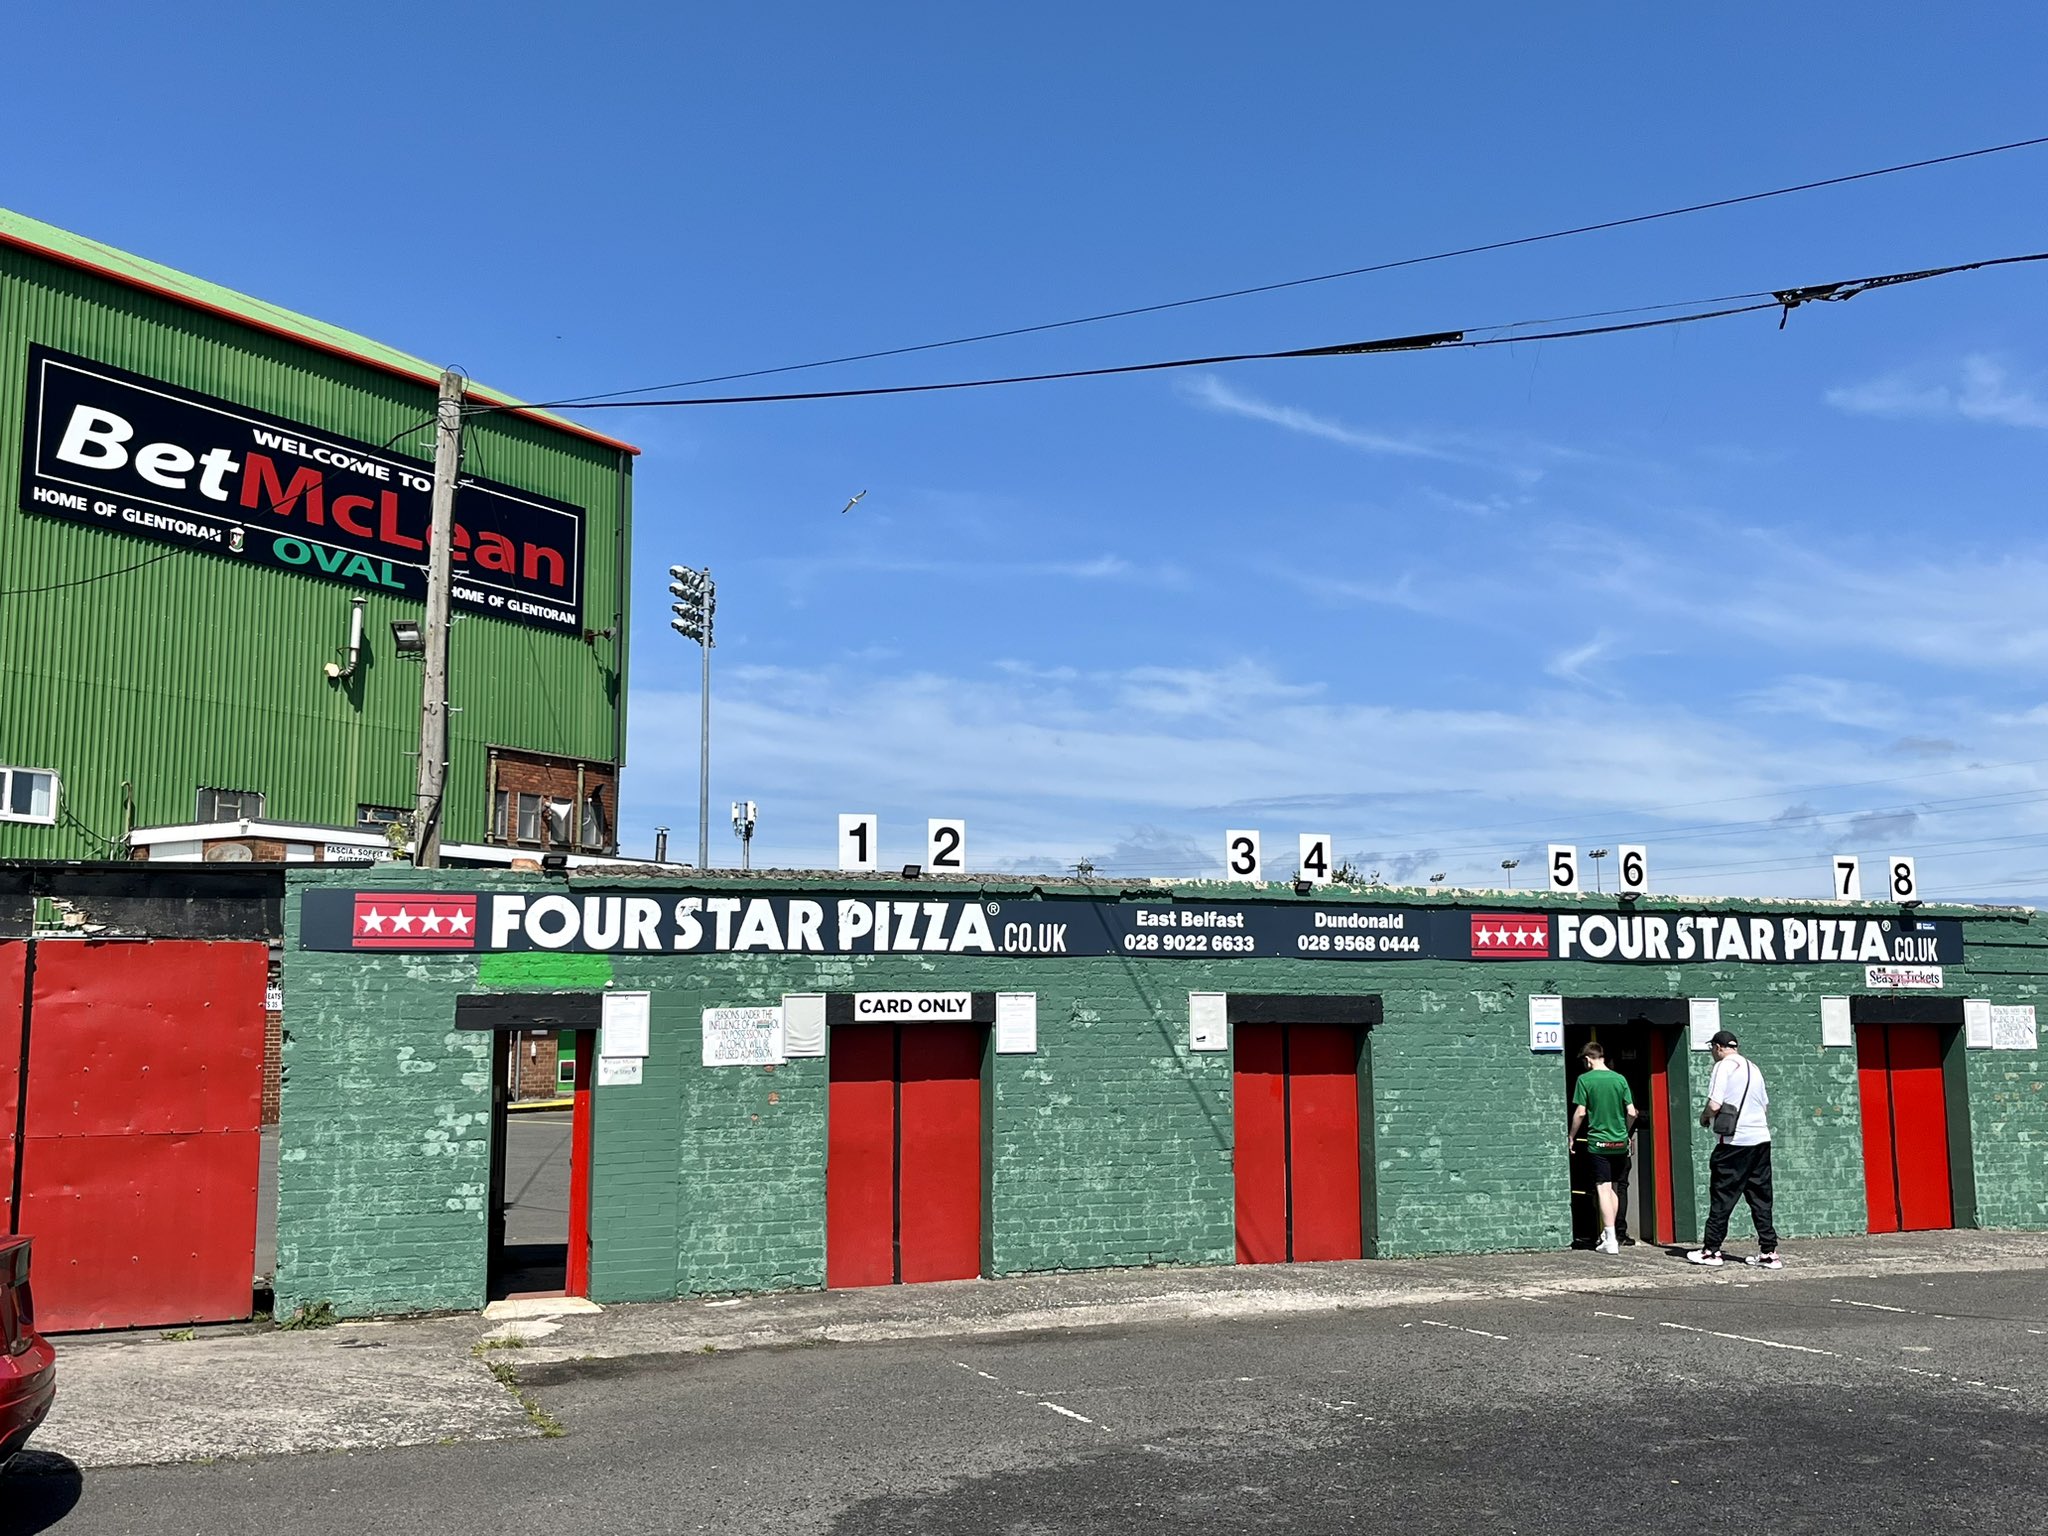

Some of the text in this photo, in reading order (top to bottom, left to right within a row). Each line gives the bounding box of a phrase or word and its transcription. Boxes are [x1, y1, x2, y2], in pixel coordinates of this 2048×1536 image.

[252, 428, 432, 492] WELCOME TO
[33, 486, 222, 543] HOME OF GLENTORAN
[272, 537, 406, 589] OVAL
[488, 594, 505, 608] OF
[507, 599, 576, 626] GLENTORAN
[848, 821, 868, 863] 1
[932, 826, 961, 867] 2
[1230, 836, 1257, 875] 3
[1303, 841, 1328, 878] 4
[1553, 851, 1574, 887] 5
[1623, 851, 1644, 887] 6
[1837, 862, 1855, 895] 7
[1894, 862, 1913, 896] 8
[490, 894, 663, 951] FOUR
[673, 896, 825, 951] STAR
[1136, 910, 1244, 928] East Belfast
[1314, 911, 1404, 929] Dundonald
[1124, 934, 1255, 952] 028 9022 6633
[1297, 935, 1420, 952] 028 9568 0444
[1557, 914, 1671, 960] FOUR
[1675, 916, 1777, 960] STAR
[1869, 969, 1940, 984] Seasn Tickets
[714, 1009, 773, 1020] PERSONS UNDER THE
[859, 998, 967, 1014] CARD ONLY
[741, 1019, 750, 1029] OF
[764, 1029, 773, 1039] OF
[1536, 1031, 1558, 1044] £10
[714, 1048, 773, 1060] REFUSED ADMISSION
